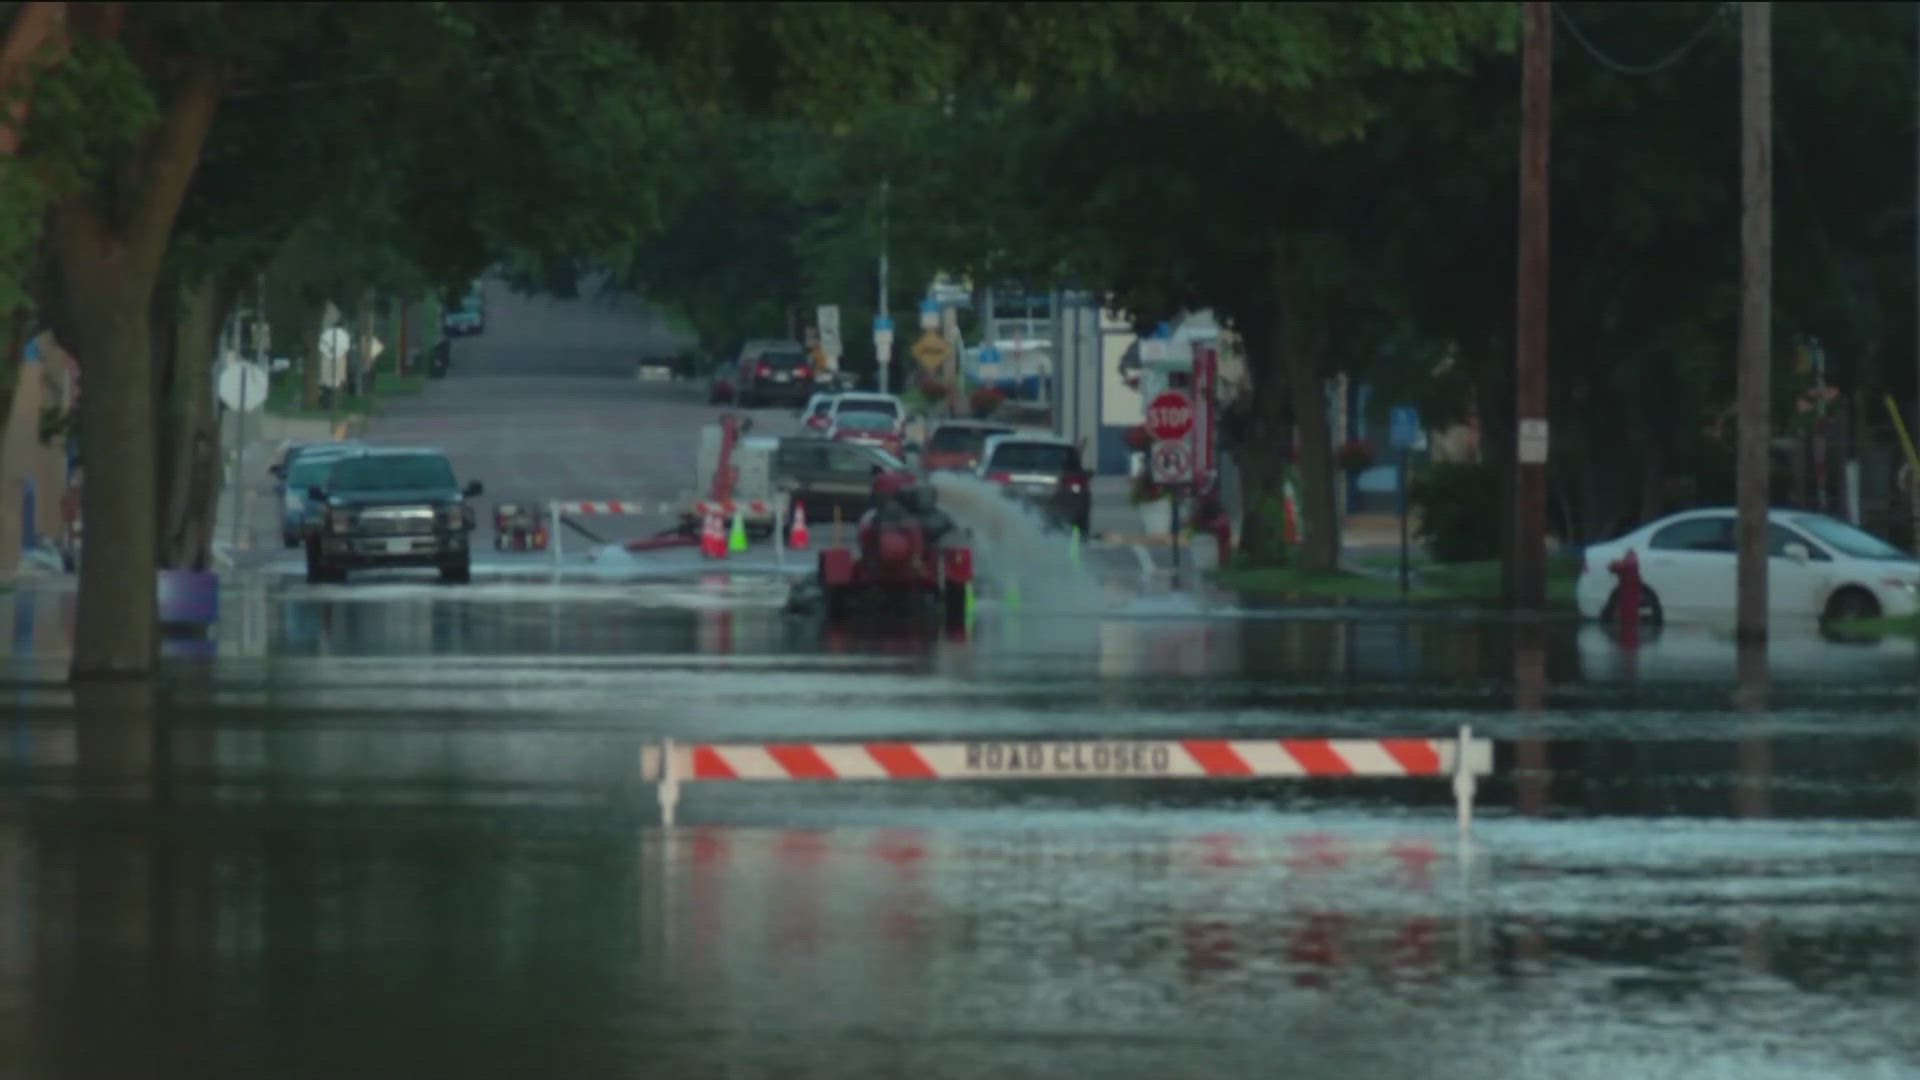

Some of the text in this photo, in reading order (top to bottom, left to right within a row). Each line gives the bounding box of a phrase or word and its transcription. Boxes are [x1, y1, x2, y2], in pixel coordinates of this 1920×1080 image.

[1147, 407, 1192, 428] STOP
[966, 743, 1170, 770] ROAD CLOSED
